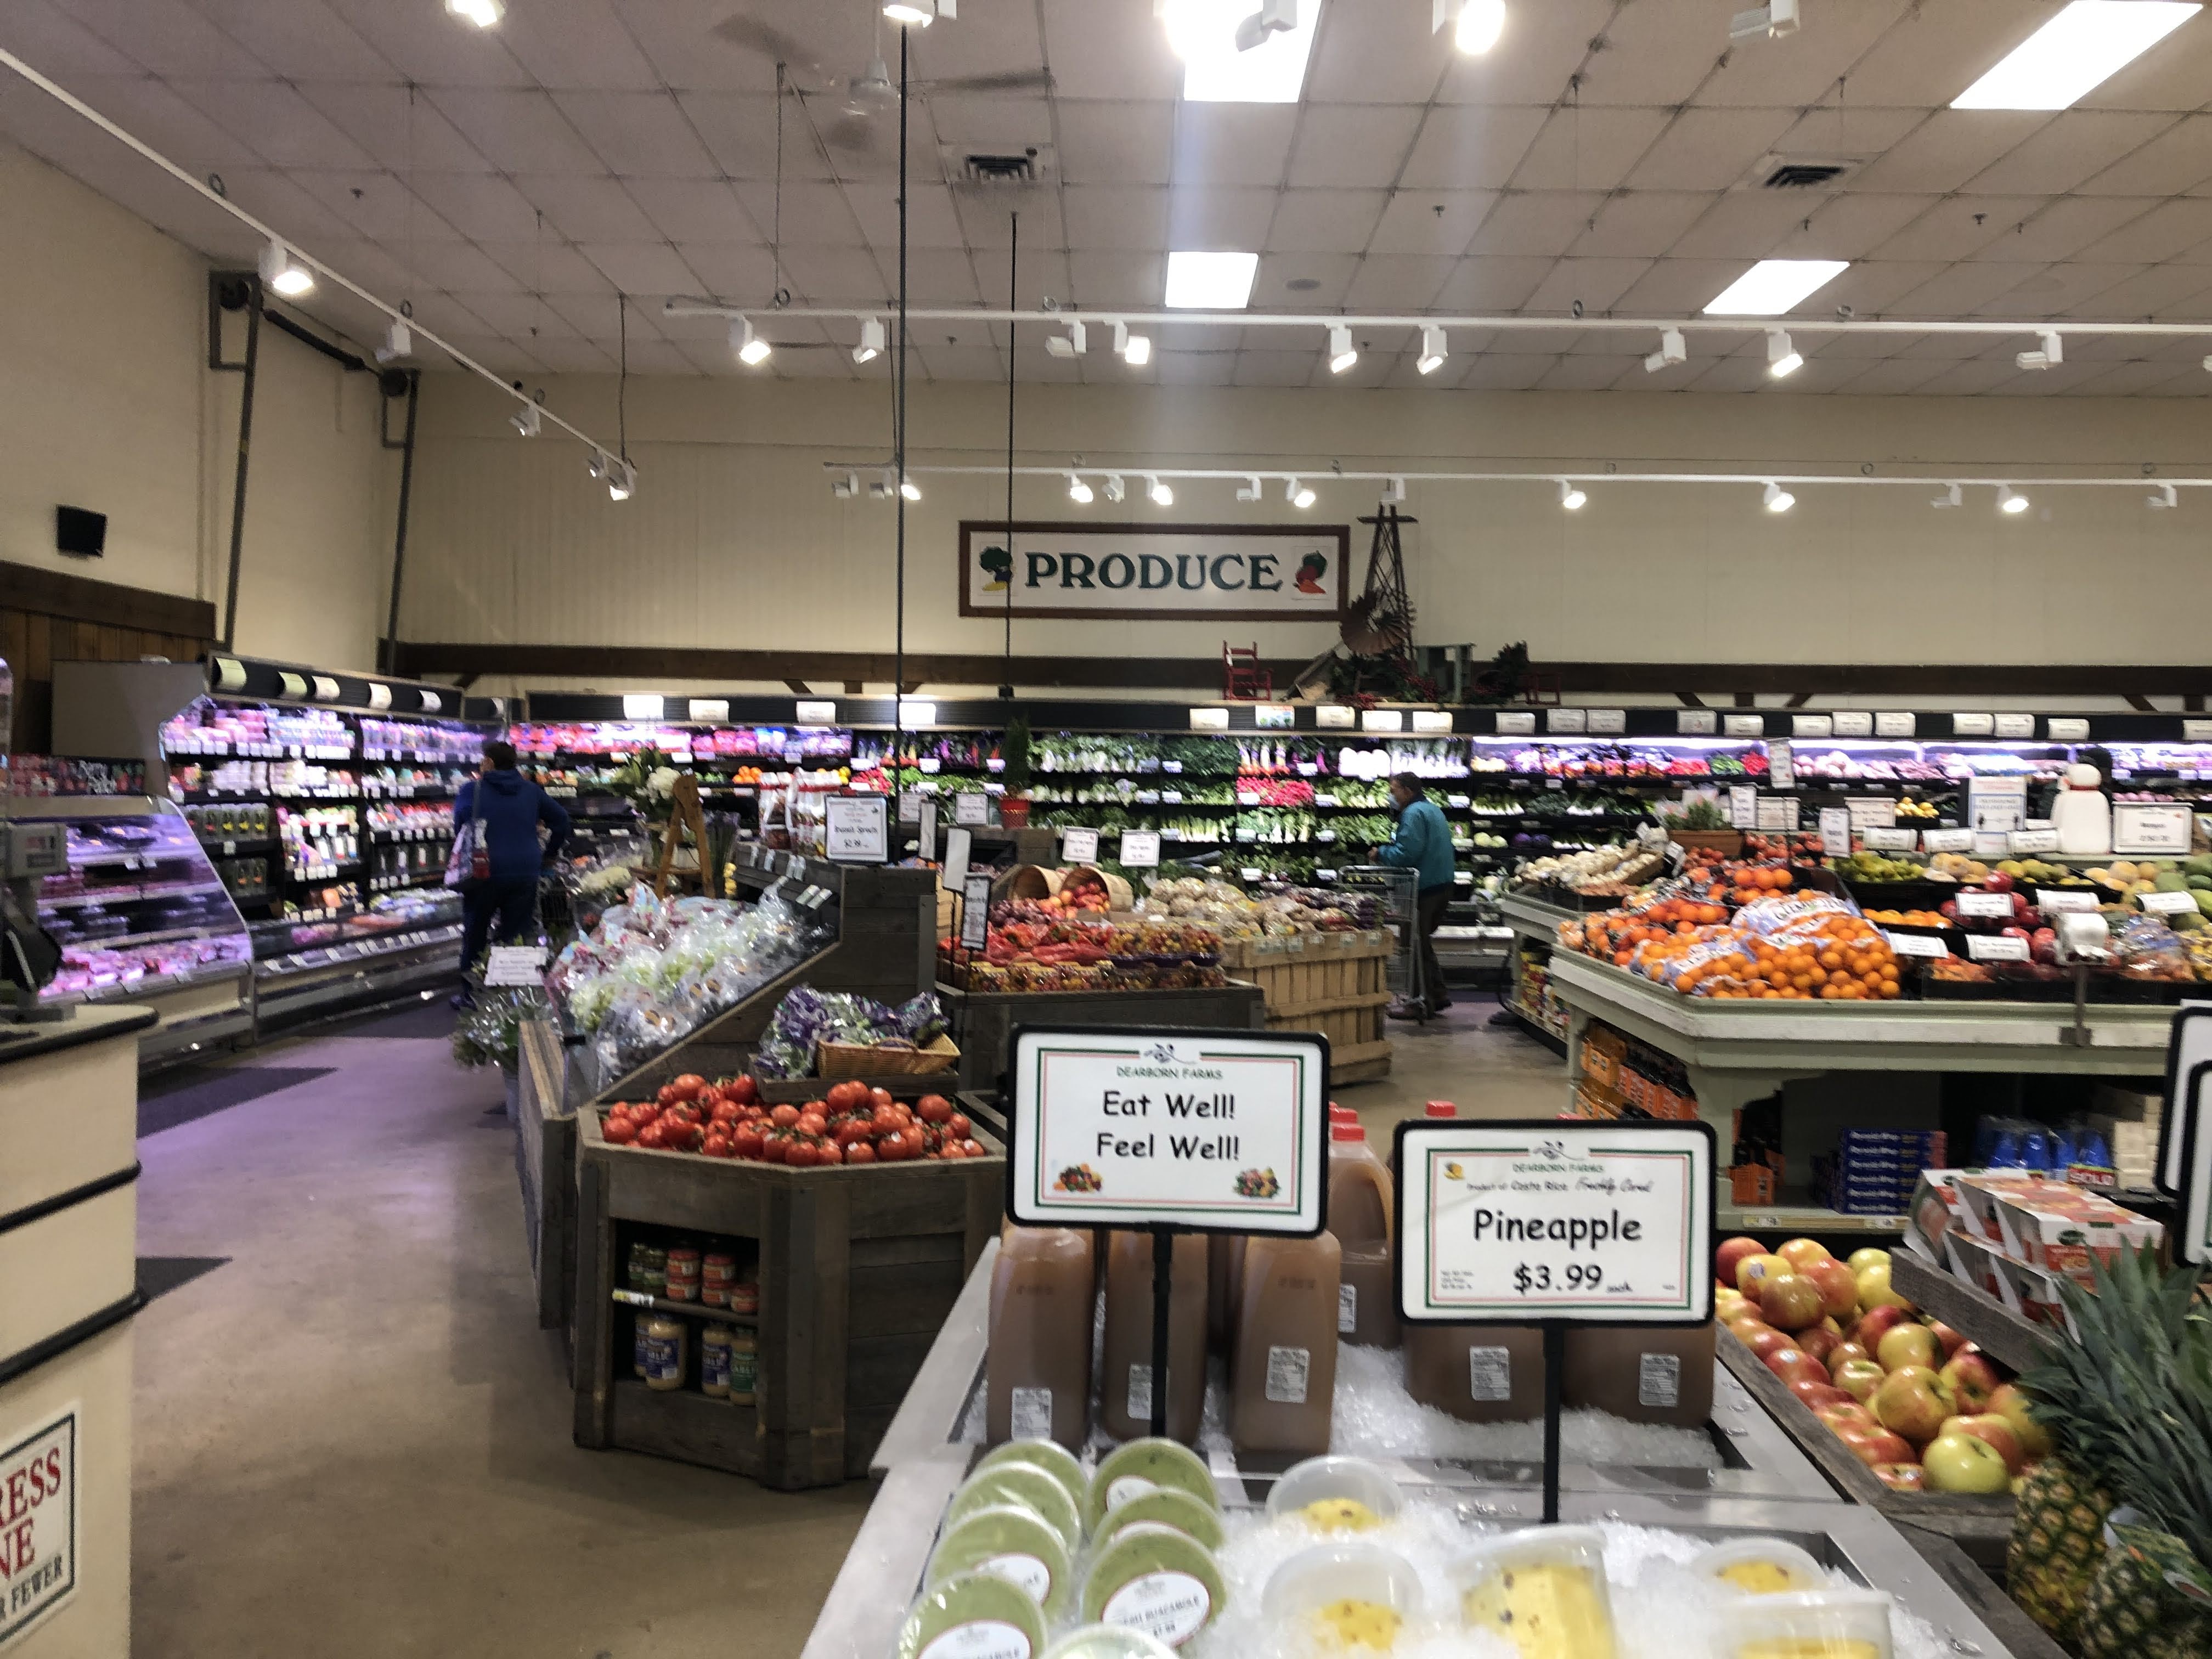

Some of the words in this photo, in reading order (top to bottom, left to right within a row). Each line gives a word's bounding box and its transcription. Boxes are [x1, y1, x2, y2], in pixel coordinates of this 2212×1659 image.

[1025, 551, 1282, 592] PRODUCE
[1116, 1066, 1179, 1079] DEARBORN
[1182, 1067, 1223, 1080] FARMS
[1103, 1090, 1150, 1117] Eat
[1165, 1093, 1235, 1119] Well!
[1097, 1132, 1154, 1157] Feel
[1169, 1135, 1240, 1160] Well!
[1472, 1208, 1643, 1251] Pineapple
[1514, 1260, 1603, 1296] $3.99
[0, 1447, 61, 1528] ESS
